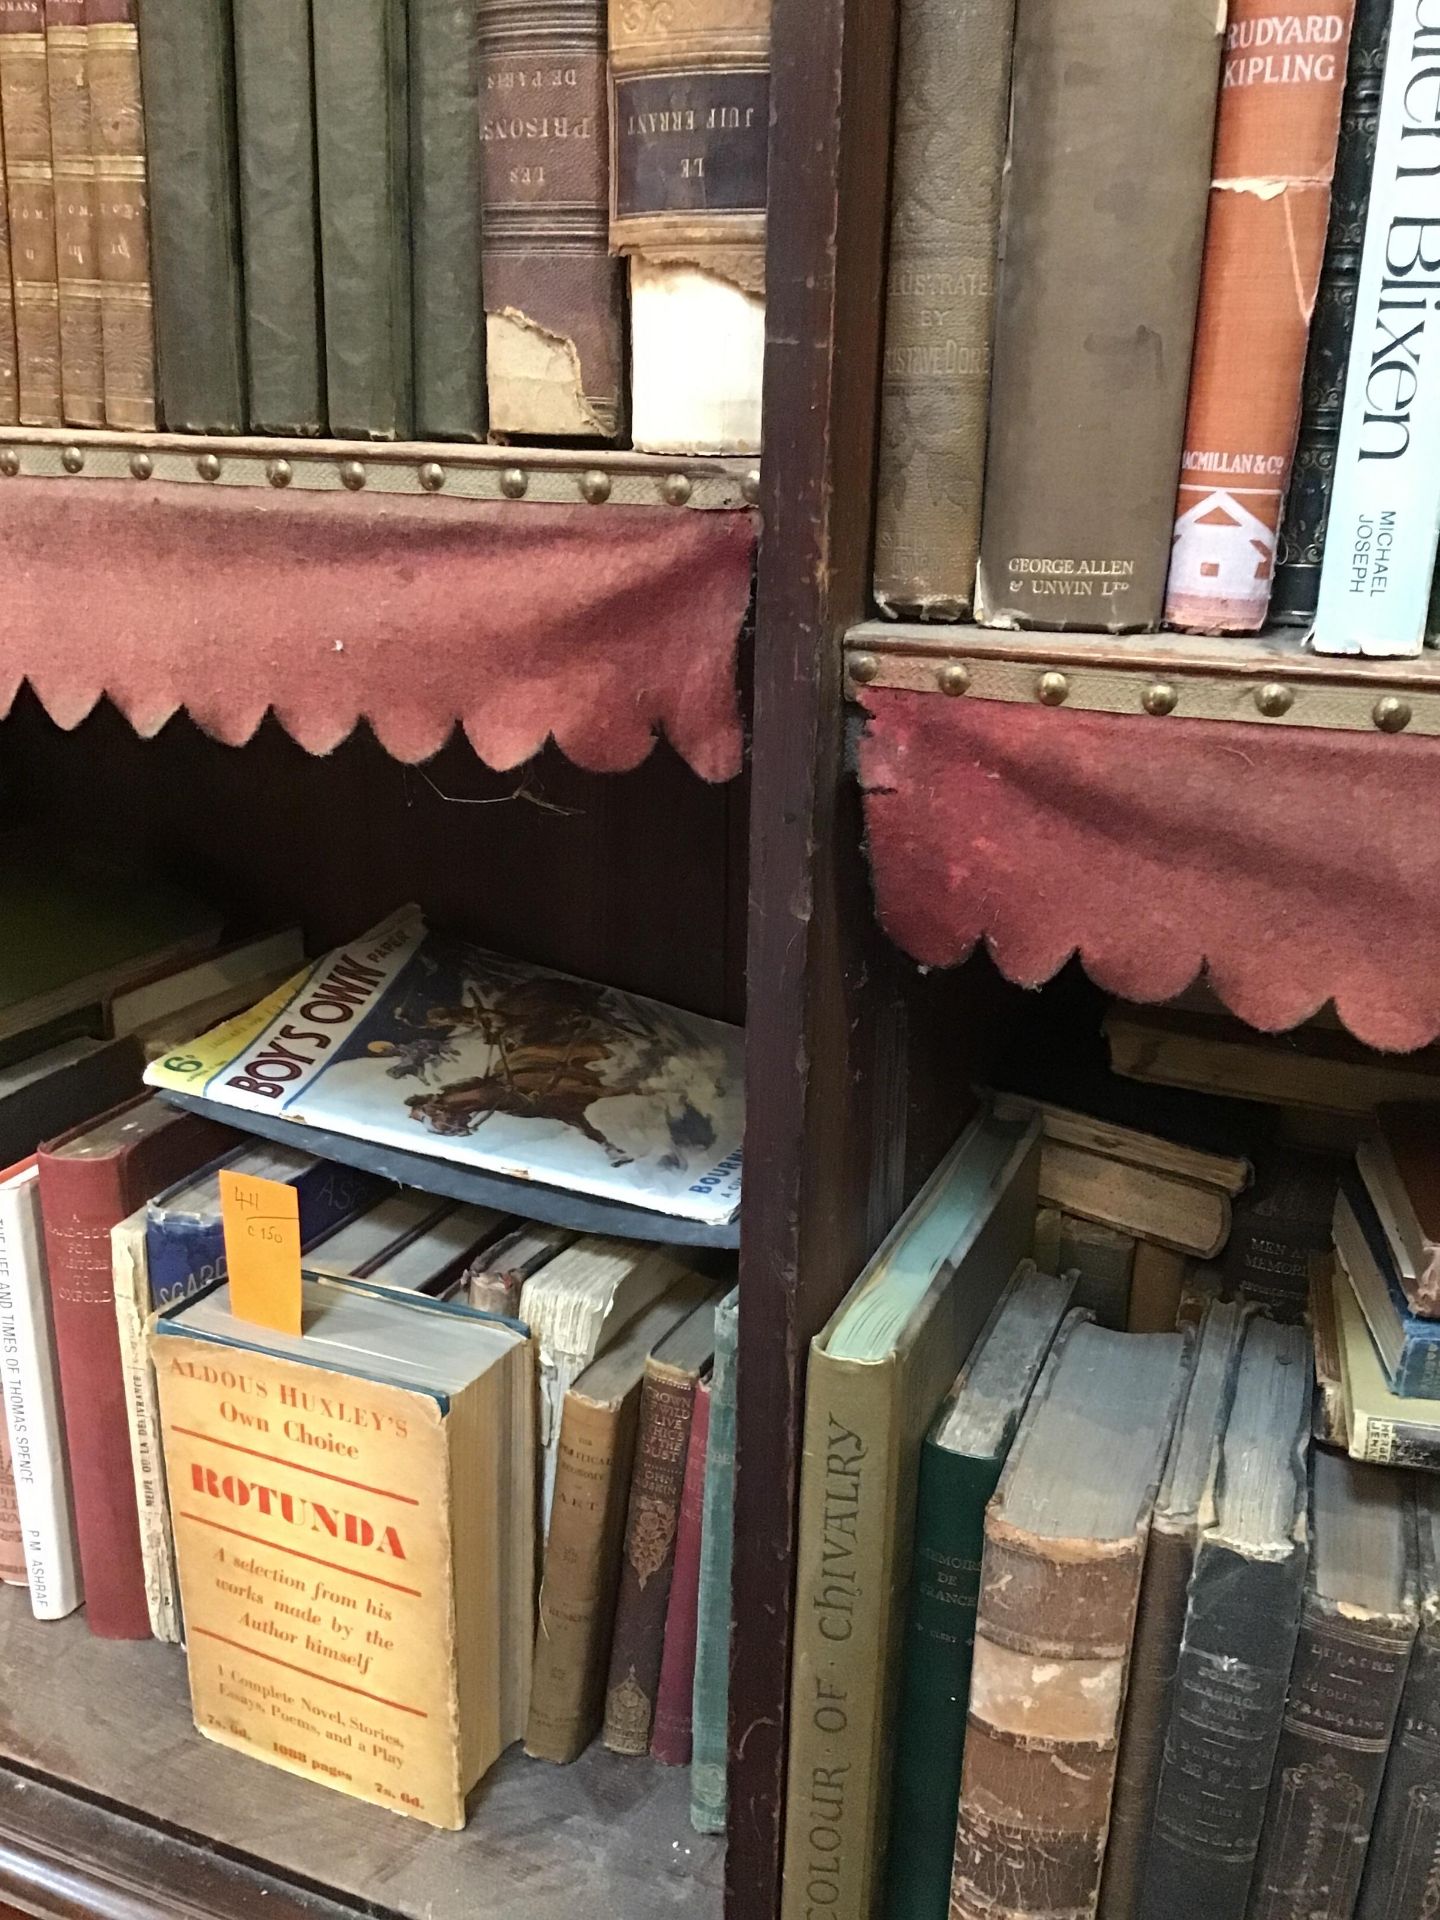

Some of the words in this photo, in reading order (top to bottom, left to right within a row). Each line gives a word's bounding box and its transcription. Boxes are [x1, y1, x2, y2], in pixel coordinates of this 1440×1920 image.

[1227, 15, 1343, 49] RUDYARD
[487, 73, 543, 89] PARIS
[552, 69, 577, 86] DE
[1224, 54, 1336, 88] KIPLING
[627, 110, 695, 135] ERRANT
[706, 107, 754, 129] JUIF
[680, 157, 705, 179] LE
[920, 310, 951, 327] BY
[1009, 557, 1074, 575] GEORGE
[1077, 558, 1135, 576] ALLEN
[1349, 514, 1374, 593] JOSEPH
[1370, 511, 1397, 597] MICHAEL
[1009, 579, 1024, 594] &
[1031, 579, 1093, 596] UNWIN
[224, 1024, 333, 1099] BOY'S
[299, 953, 388, 1023] OWN
[688, 1149, 742, 1194] BOURN
[59, 1288, 113, 1303] OXFORD
[73, 1275, 91, 1287] TO
[2, 1313, 18, 1353] TIMES
[8, 1357, 20, 1375] OF
[10, 1379, 26, 1432] THOMAS
[170, 1357, 268, 1398] ALDOUS
[280, 1383, 409, 1438] HUXLEY'S
[139, 1442, 149, 1455] LA
[220, 1401, 271, 1433] Own
[283, 1420, 360, 1460] Choice
[16, 1435, 33, 1485] SPENCE
[643, 1443, 680, 1463] DUST
[191, 1463, 407, 1560] ROTUNDA
[32, 1559, 49, 1608] ASHRAF
[233, 1553, 307, 1592] selection
[312, 1581, 358, 1611] from
[365, 1596, 393, 1621] his
[937, 1571, 958, 1586] DE
[215, 1575, 265, 1607] works
[274, 1596, 322, 1627] made
[332, 1610, 355, 1641] by
[365, 1623, 395, 1652] the
[239, 1611, 298, 1646] Author
[305, 1634, 375, 1676] himself
[230, 1669, 295, 1705] Complete
[300, 1696, 346, 1727] Novel,
[349, 1715, 405, 1751] Stories,
[815, 1677, 849, 1734] OF
[271, 1703, 321, 1736] Poems,
[325, 1729, 353, 1748] and
[358, 1743, 367, 1753] a
[372, 1743, 406, 1771] Play
[312, 1759, 354, 1783] pages
